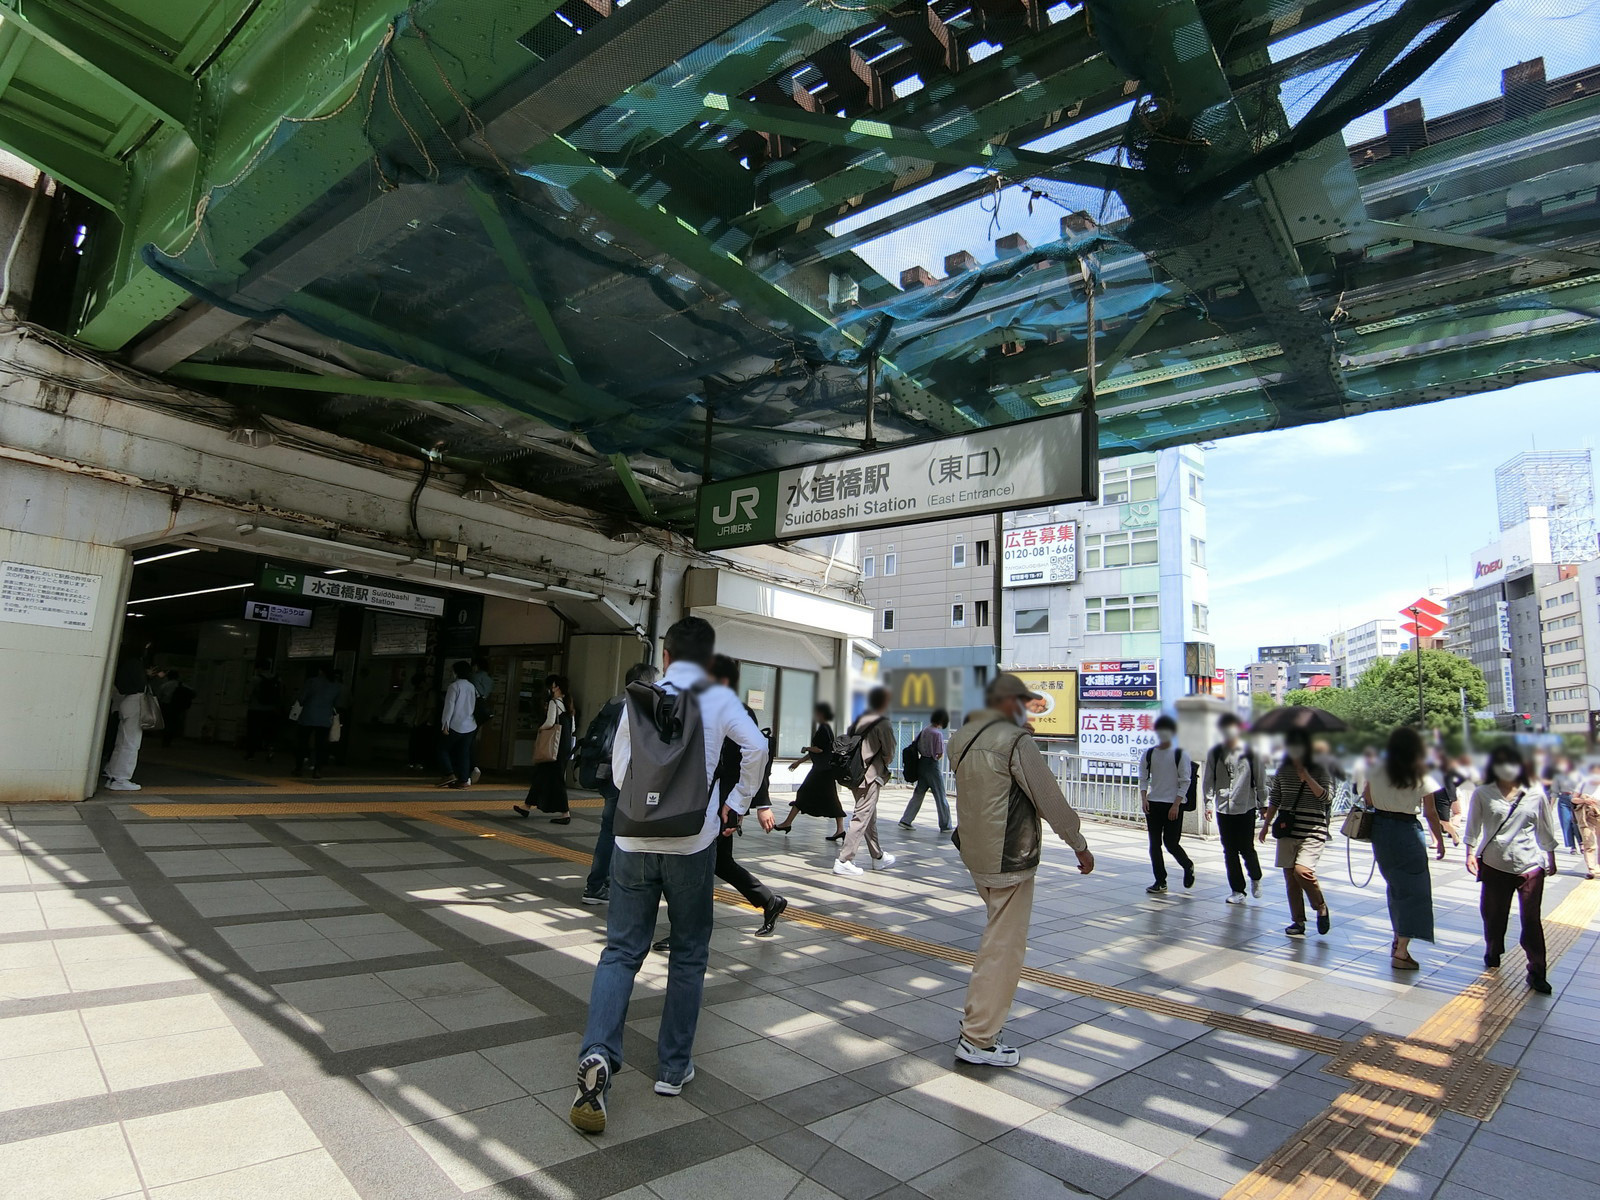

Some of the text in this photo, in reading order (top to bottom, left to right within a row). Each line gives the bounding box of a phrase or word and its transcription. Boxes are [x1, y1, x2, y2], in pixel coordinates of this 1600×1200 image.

[786, 447, 1001, 508] 水道橋駅 （東口）
[713, 486, 760, 525] JR
[785, 482, 1015, 527] Suidōbashi Station (East Entrance)
[717, 522, 752, 537] JR東日本
[1005, 525, 1074, 549] 広告募集
[1005, 544, 1074, 560] 0120-081-666
[275, 574, 297, 587] JR
[311, 580, 369, 601] 水道橋駅
[371, 597, 395, 606] Station
[1085, 674, 1152, 686] 水道橋チケット
[1081, 714, 1155, 731] 広告募集
[1081, 734, 1155, 745] 0120-081-666
